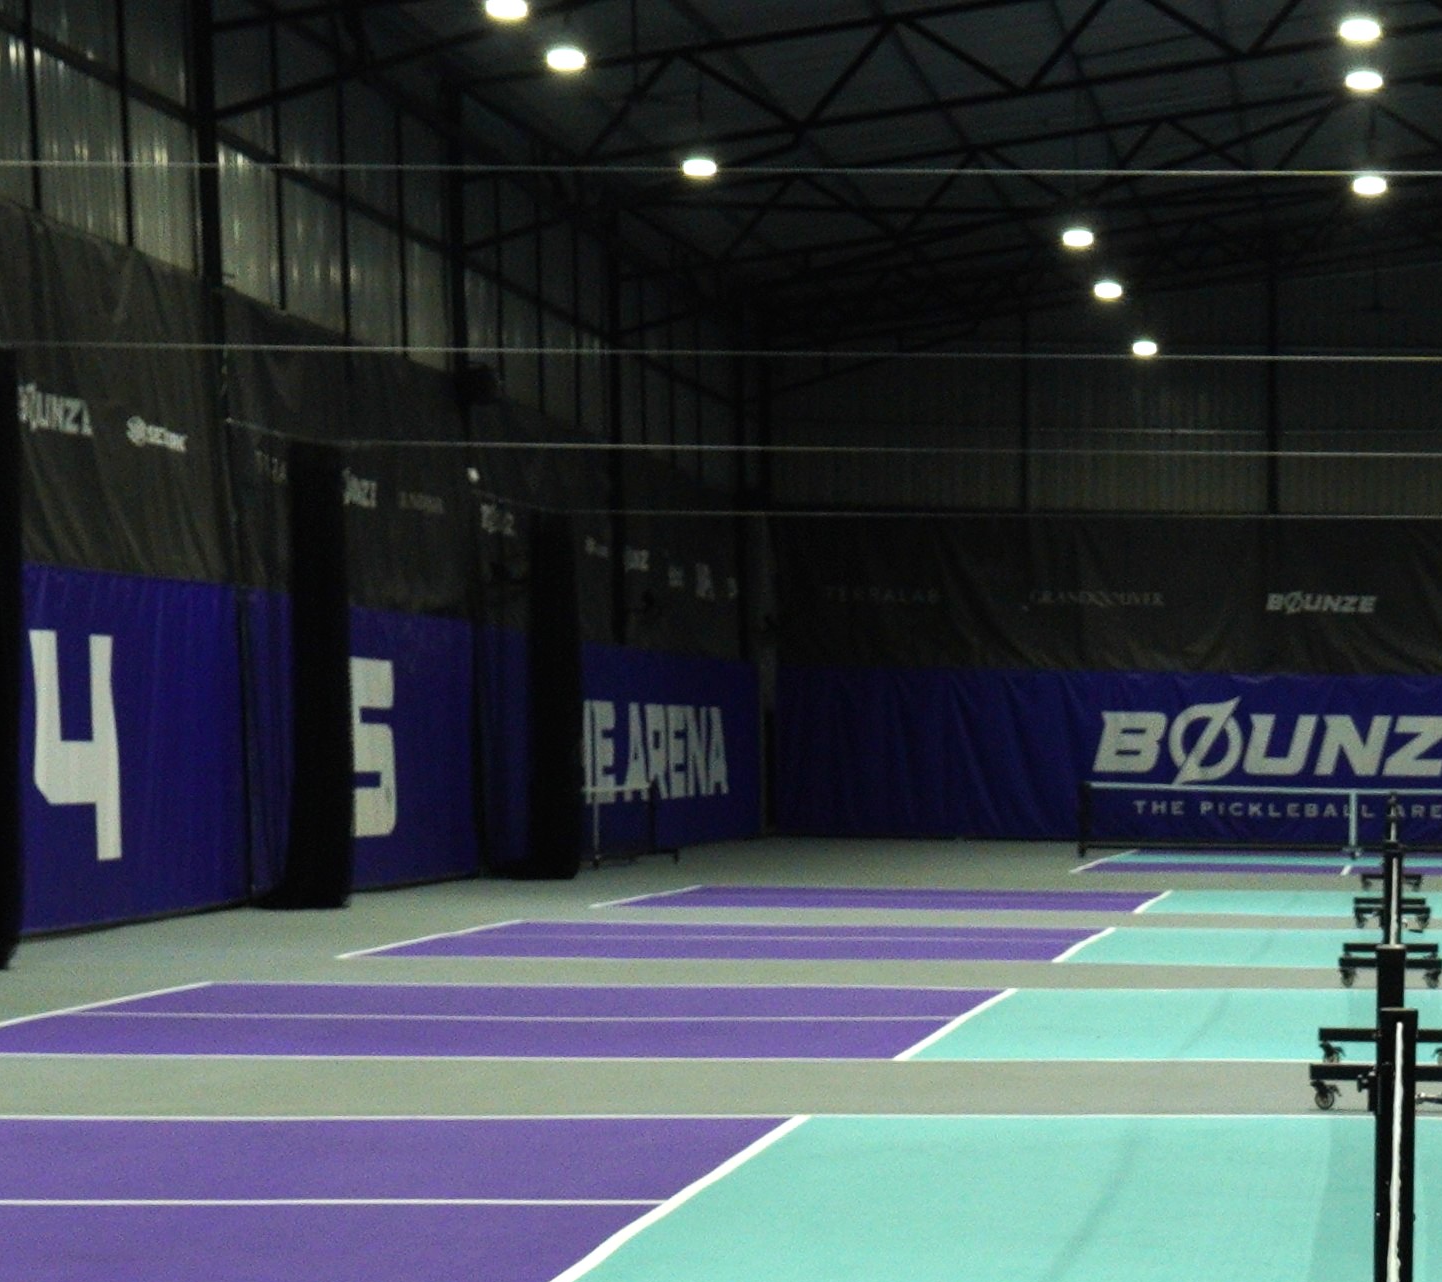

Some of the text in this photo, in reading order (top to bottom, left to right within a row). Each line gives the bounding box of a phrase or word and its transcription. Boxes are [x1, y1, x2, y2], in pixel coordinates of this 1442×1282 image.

[28, 629, 122, 861] 4
[349, 657, 398, 839] 5
[624, 702, 729, 802] ARENA
[1133, 800, 1185, 816] THE
[1200, 800, 1375, 819] PICKLEBALL
